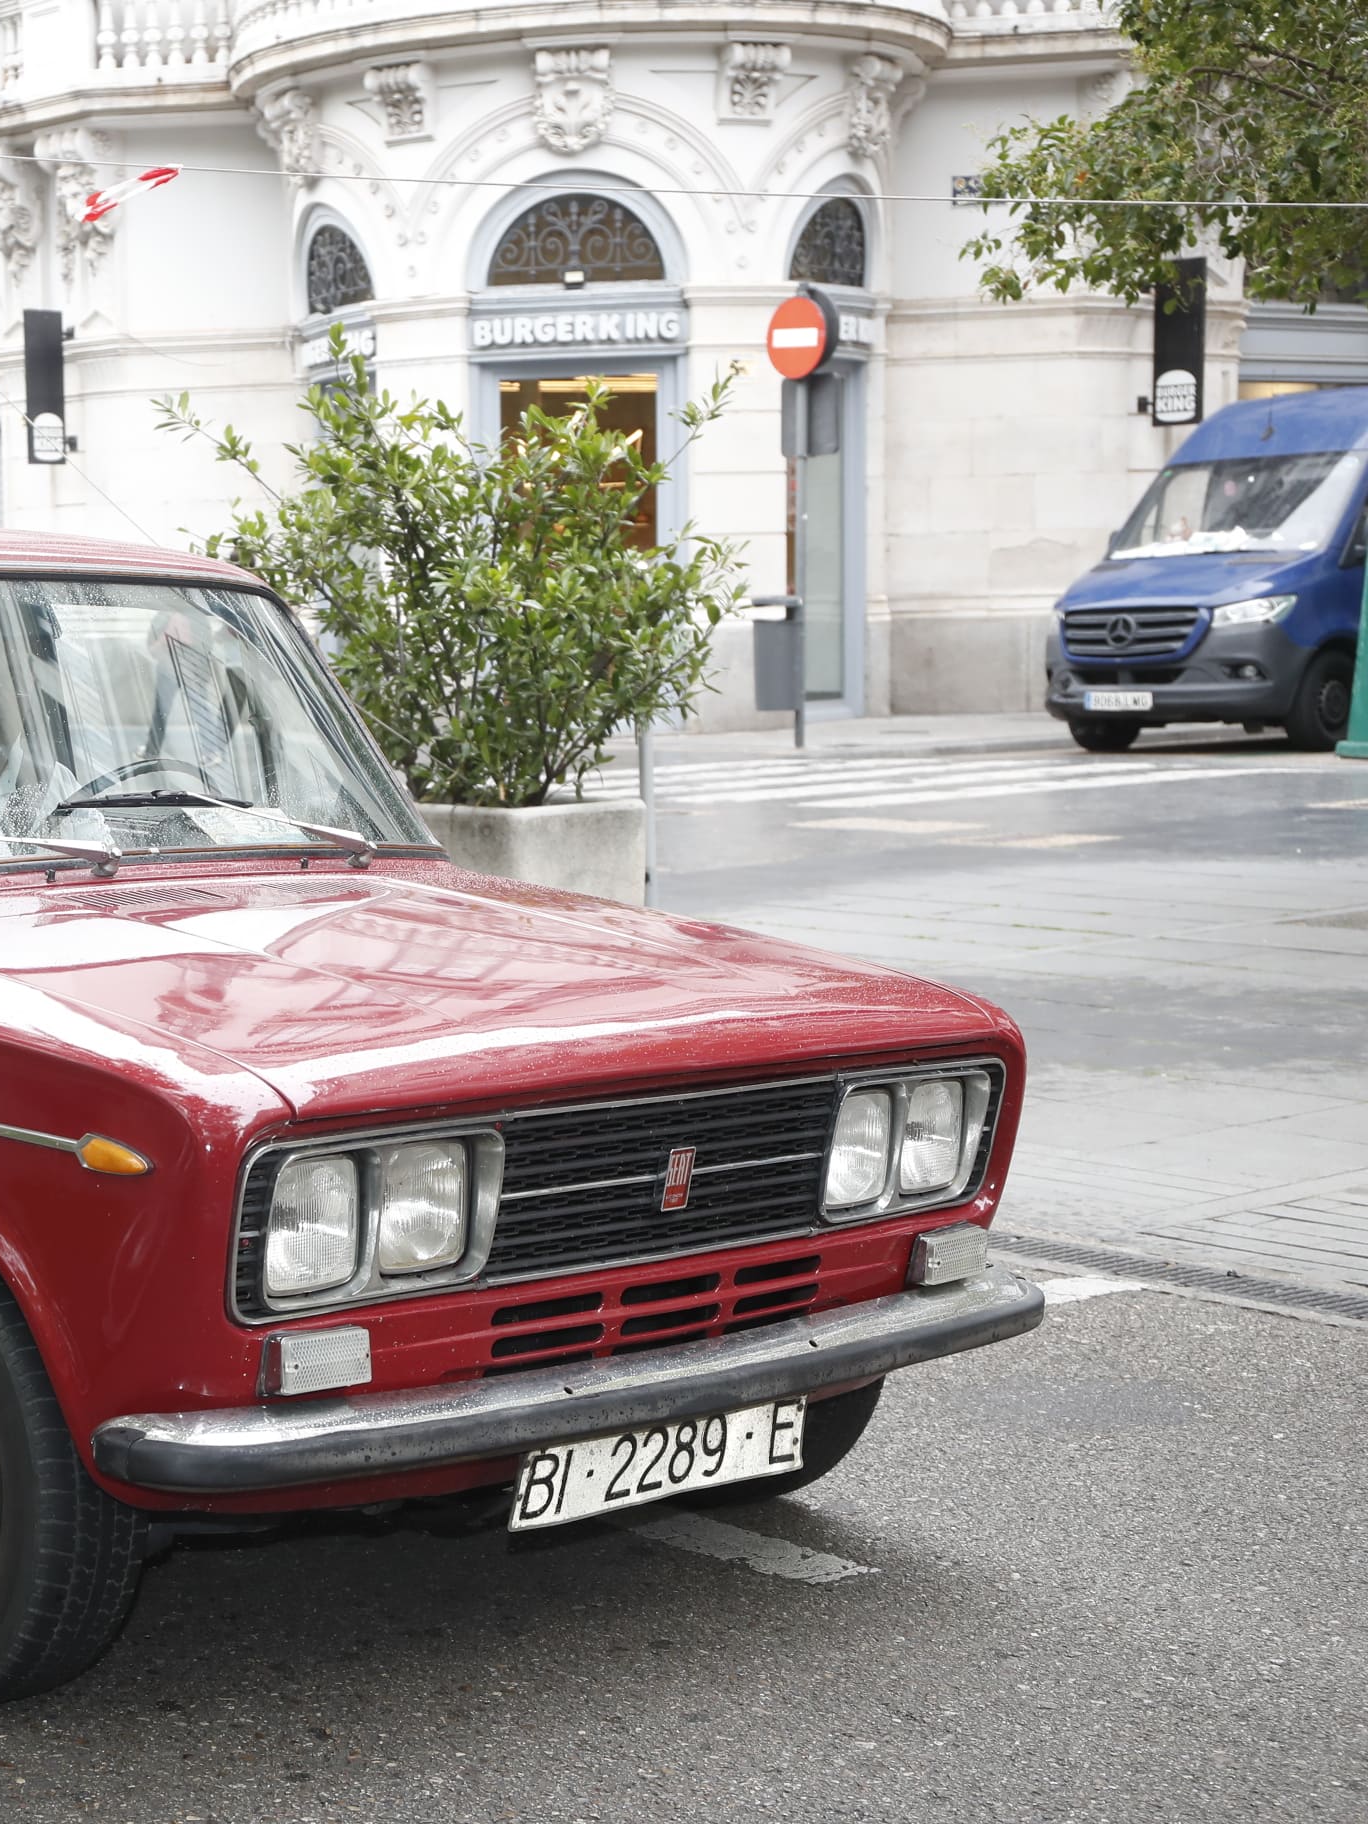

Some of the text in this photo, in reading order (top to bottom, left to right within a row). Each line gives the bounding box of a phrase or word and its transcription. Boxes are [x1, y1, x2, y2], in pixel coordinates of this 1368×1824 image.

[473, 311, 681, 347] BURGER KING
[1156, 396, 1197, 412] KING
[666, 1152, 693, 1187] SEAT
